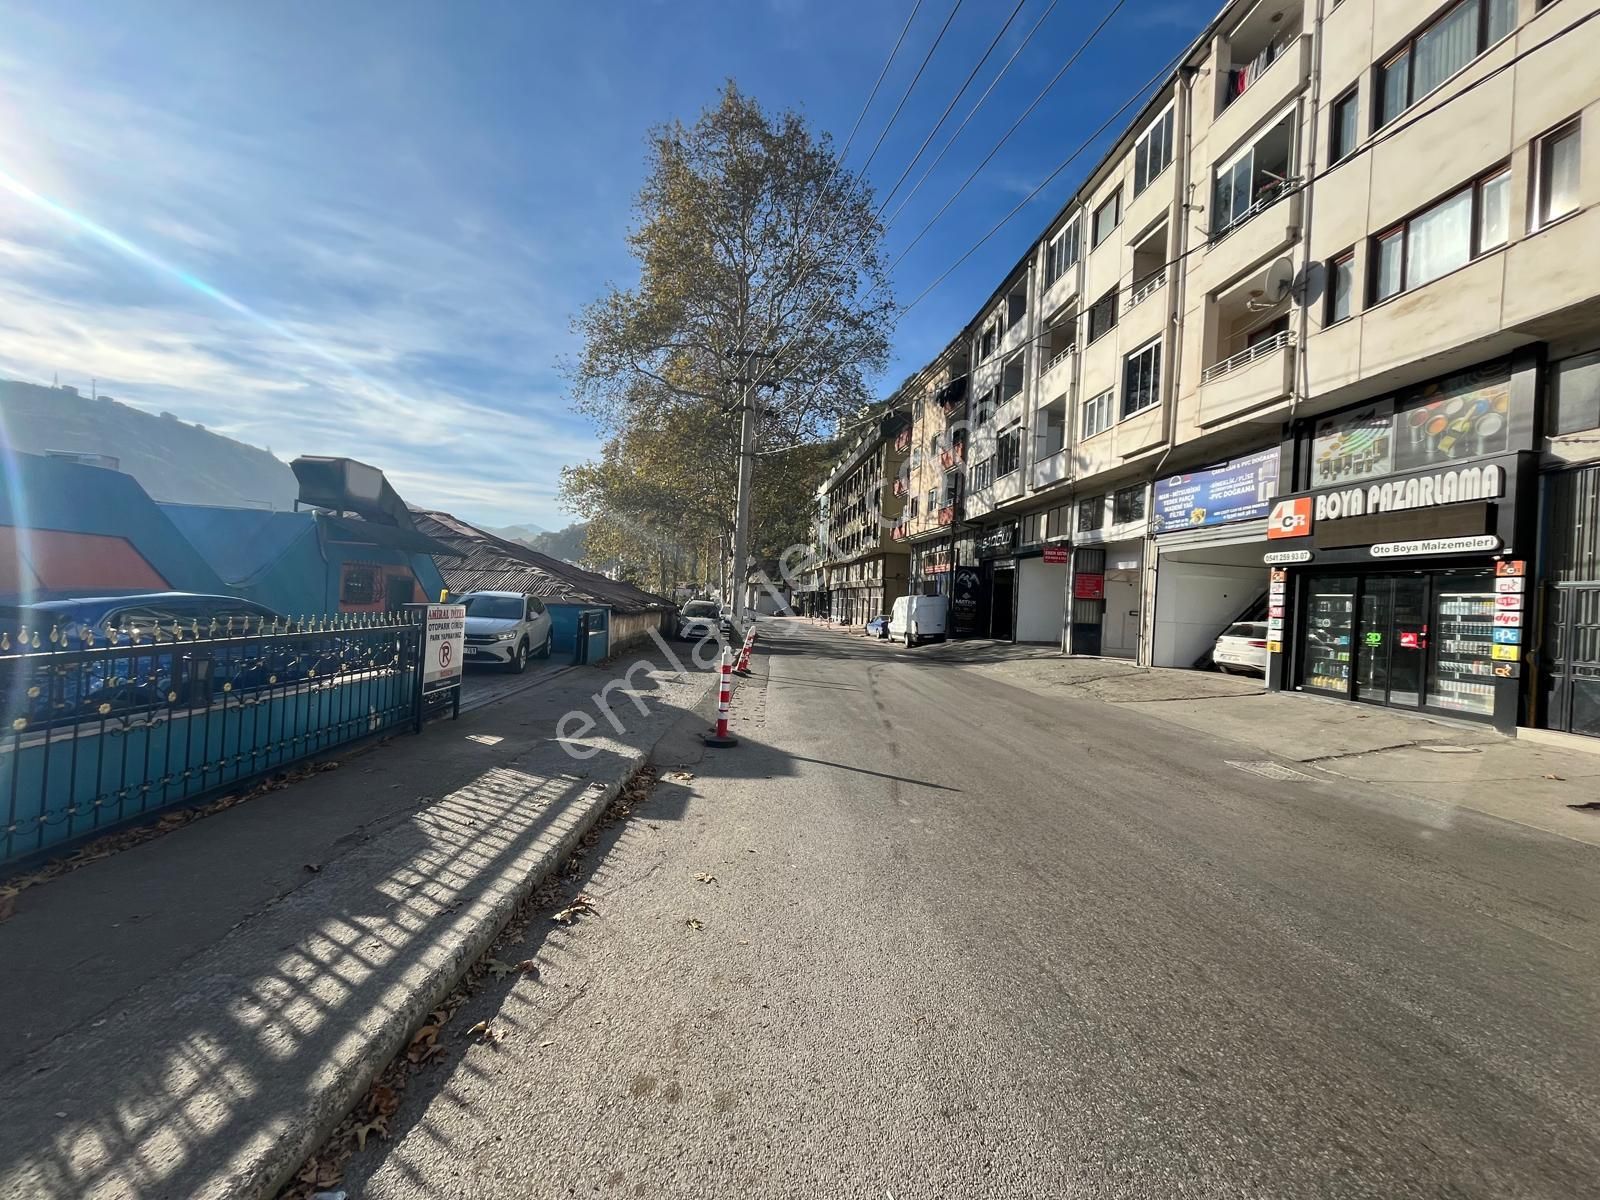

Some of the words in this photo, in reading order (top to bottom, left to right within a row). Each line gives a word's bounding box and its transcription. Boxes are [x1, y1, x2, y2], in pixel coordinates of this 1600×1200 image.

[1316, 488, 1363, 521] BOYA
[1367, 464, 1499, 513] PAZARLAMA
[1373, 546, 1391, 555] Oto
[1393, 543, 1419, 555] Boya
[1421, 538, 1494, 553] Malzemeleri
[1495, 613, 1519, 625] dyo
[428, 622, 450, 632] OTOPARK
[1495, 629, 1517, 643] PPG
